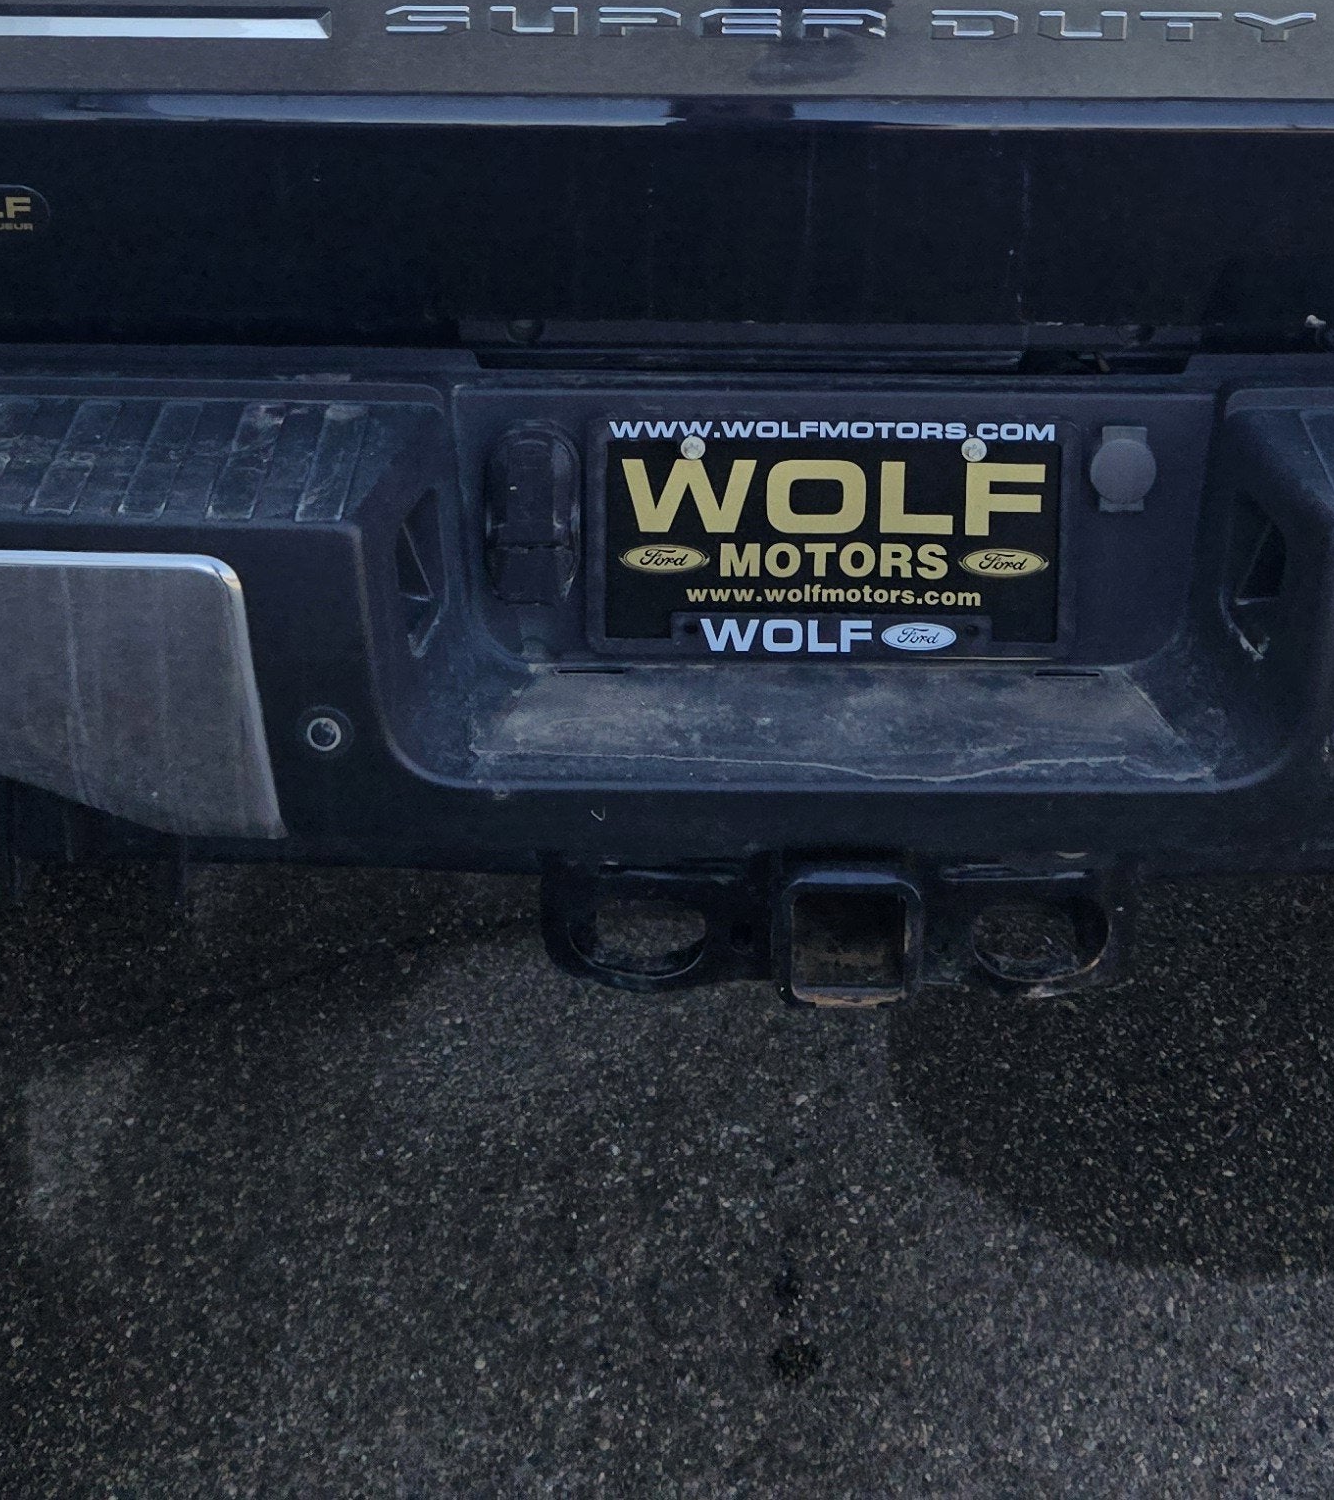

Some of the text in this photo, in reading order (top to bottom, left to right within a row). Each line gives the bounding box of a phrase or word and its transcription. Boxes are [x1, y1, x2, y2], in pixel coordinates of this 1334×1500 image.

[384, 5, 1319, 43] SUPER DUTY
[609, 420, 1056, 442] WWW.WOLFMOTORS.COM
[621, 458, 1046, 537] WOLF
[639, 542, 1028, 580] Ford MOTORS Ford
[686, 584, 981, 607] www.wolfmotors.com
[699, 618, 941, 653] WOLF Ford
